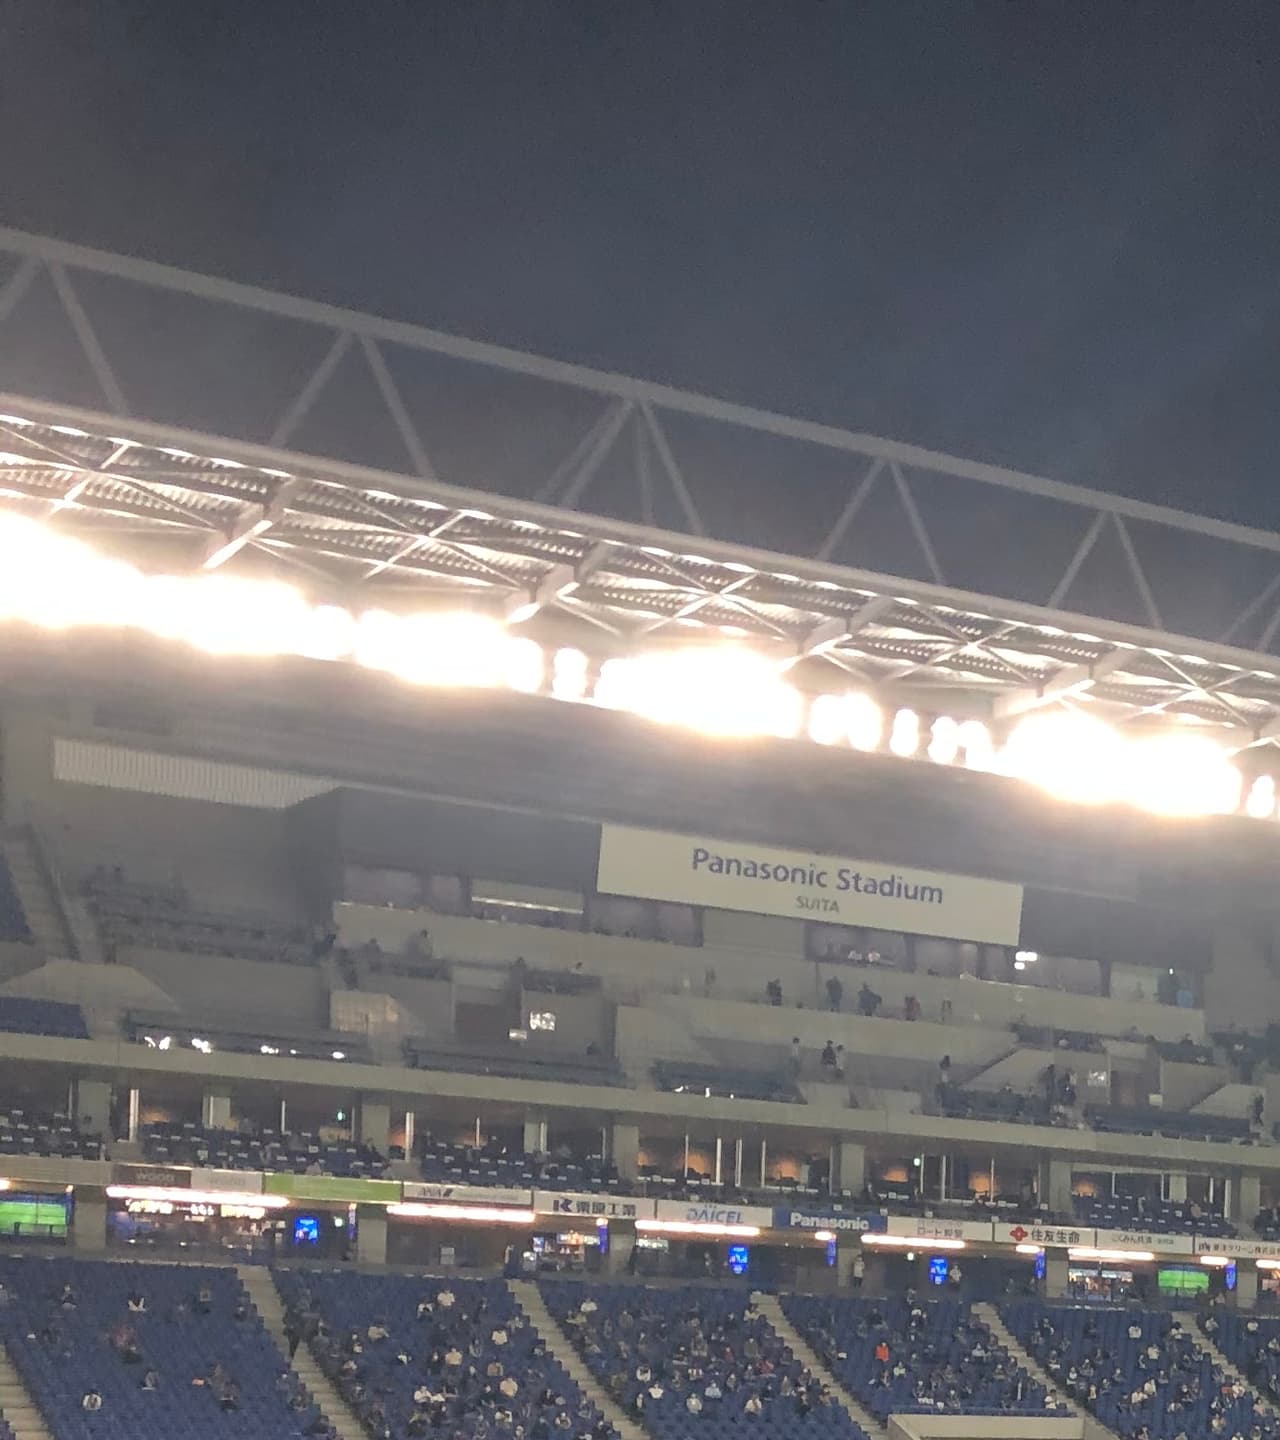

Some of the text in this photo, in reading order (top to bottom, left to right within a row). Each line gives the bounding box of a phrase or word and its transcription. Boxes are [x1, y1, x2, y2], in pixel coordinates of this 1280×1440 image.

[692, 847, 944, 904] Panasonic Stadium
[795, 896, 840, 914] SUITA
[685, 1206, 745, 1224] DAICEL
[790, 1211, 870, 1231] Panasonic
[1031, 1228, 1081, 1244] 住友生命
